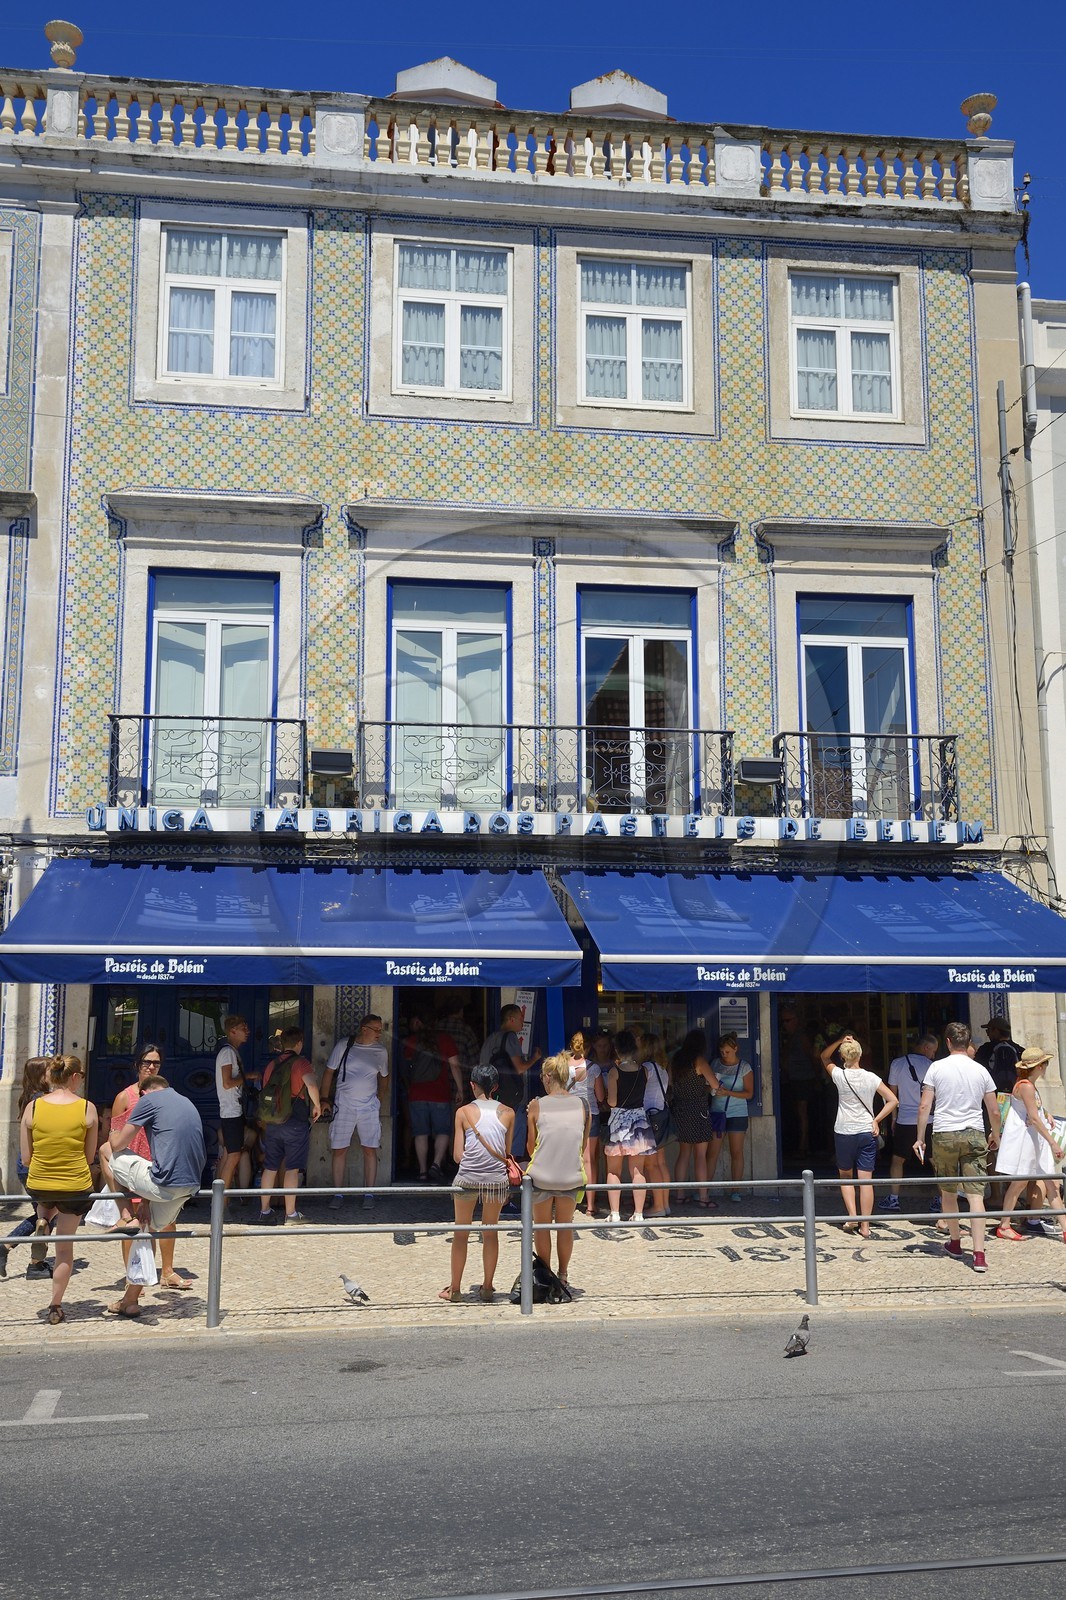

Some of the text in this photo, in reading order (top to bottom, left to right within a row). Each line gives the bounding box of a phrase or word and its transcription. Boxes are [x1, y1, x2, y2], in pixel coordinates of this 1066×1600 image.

[463, 811, 535, 834] DOS
[779, 817, 822, 841] DE
[105, 957, 204, 974] Pastéis de Belém
[386, 960, 479, 976] Pastéis de Belém
[696, 966, 786, 981] Pastéis de Belém
[948, 968, 1035, 983] Pastéis de Belém
[717, 1245, 871, 1263] 1837
